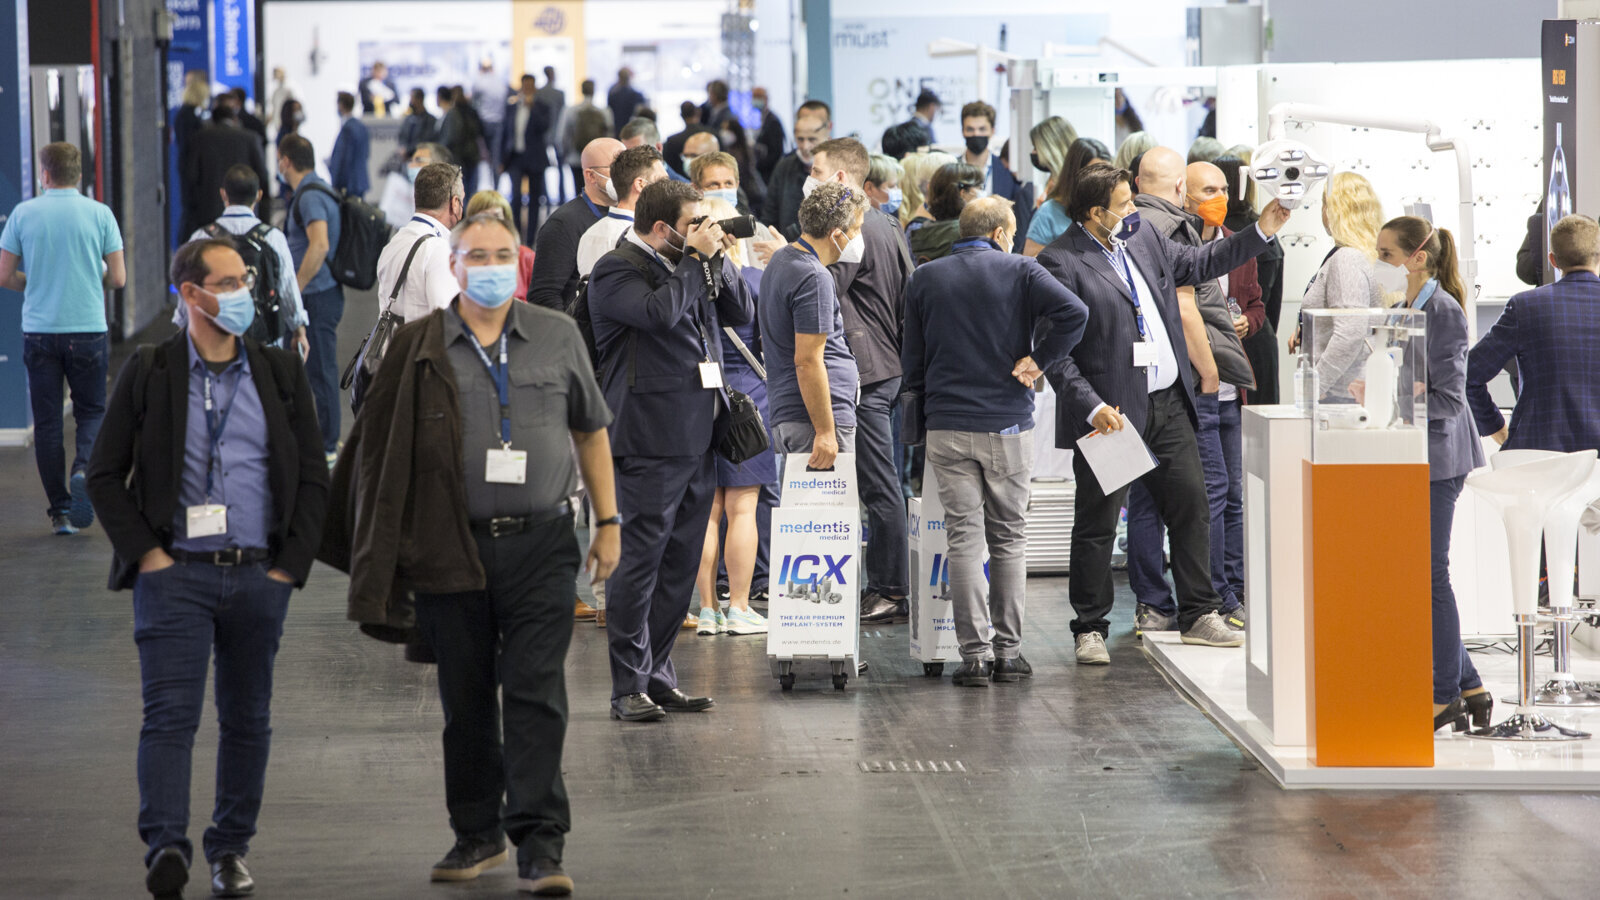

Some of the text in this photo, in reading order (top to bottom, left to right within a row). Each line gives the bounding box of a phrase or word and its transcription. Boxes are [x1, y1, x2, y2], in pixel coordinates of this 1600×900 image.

[789, 478, 847, 489] medentis
[780, 520, 850, 533] medentis
[778, 554, 852, 585] ICX
